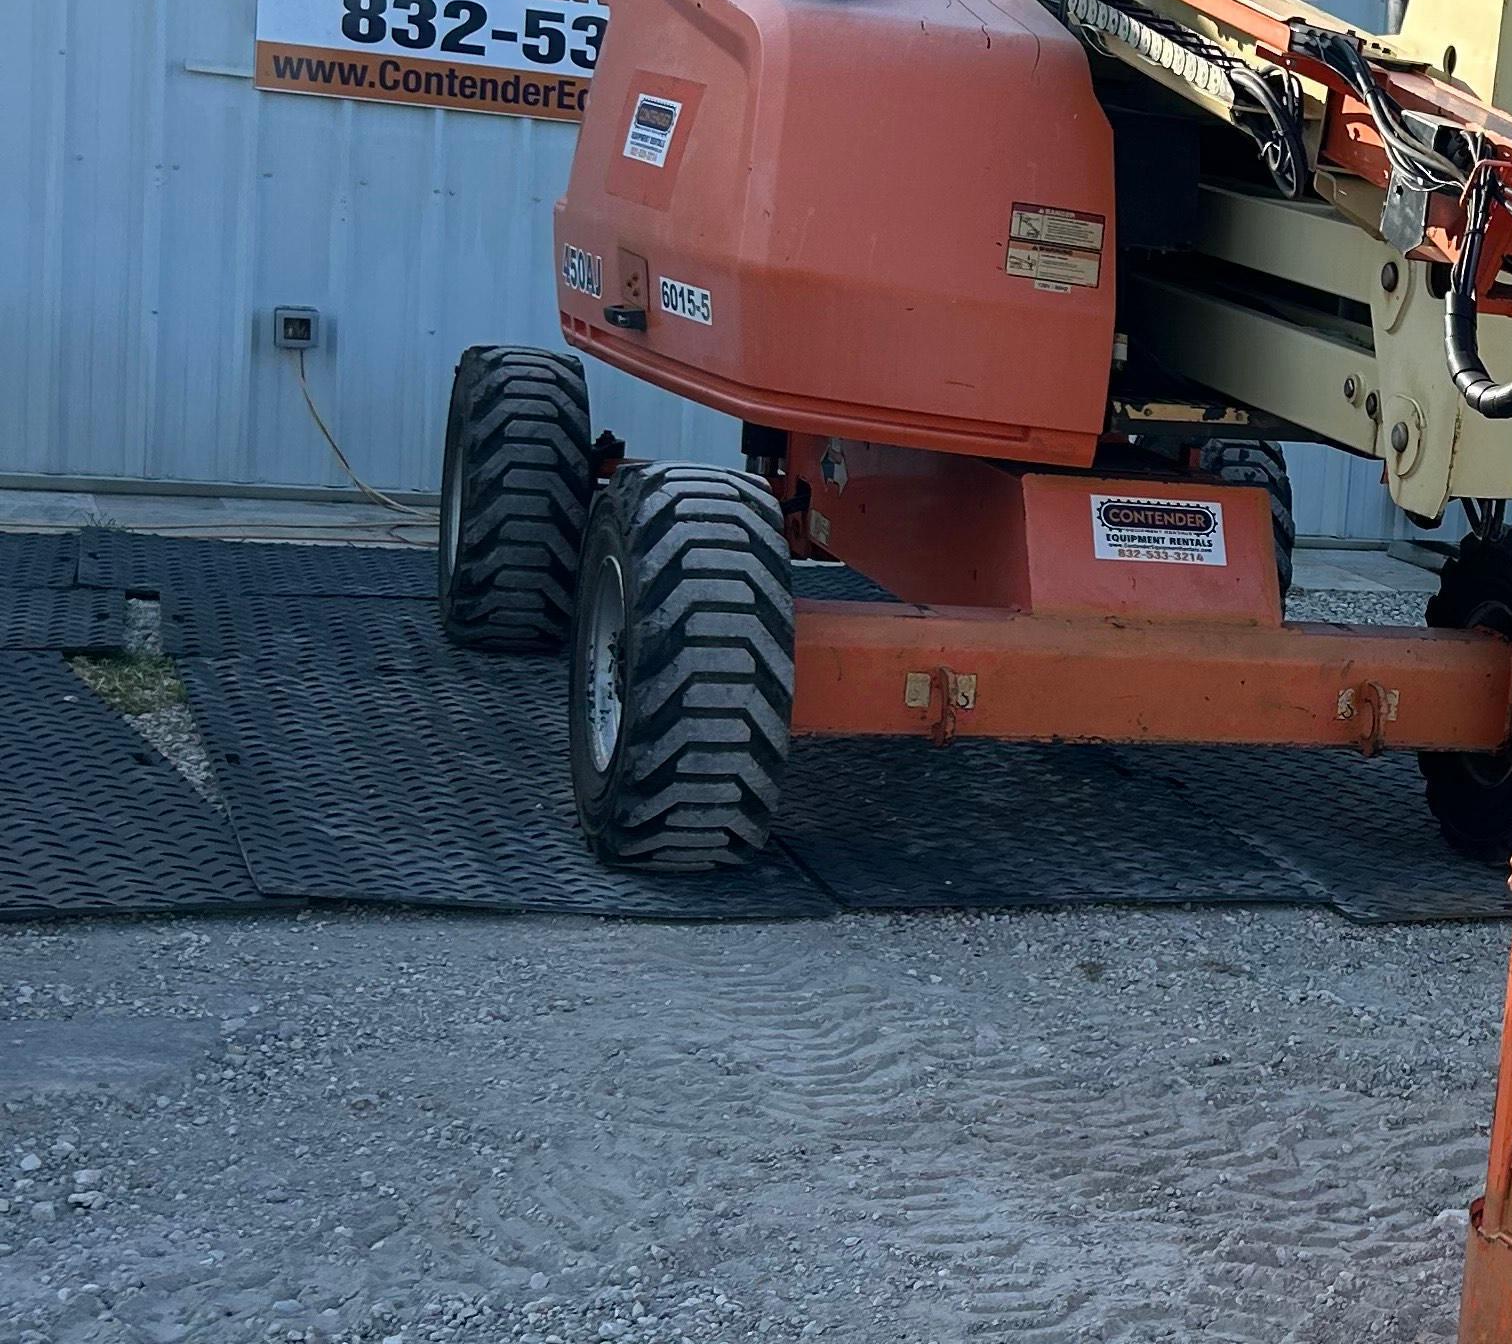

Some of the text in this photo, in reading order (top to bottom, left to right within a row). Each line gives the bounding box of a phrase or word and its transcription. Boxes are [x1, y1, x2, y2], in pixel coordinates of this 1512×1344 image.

[562, 243, 603, 299] 450AJ
[661, 280, 711, 321] 6015-5
[1108, 508, 1206, 528] CONTENDER
[1105, 533, 1166, 545] EQUIPMENT
[1169, 537, 1213, 548] RENTALS
